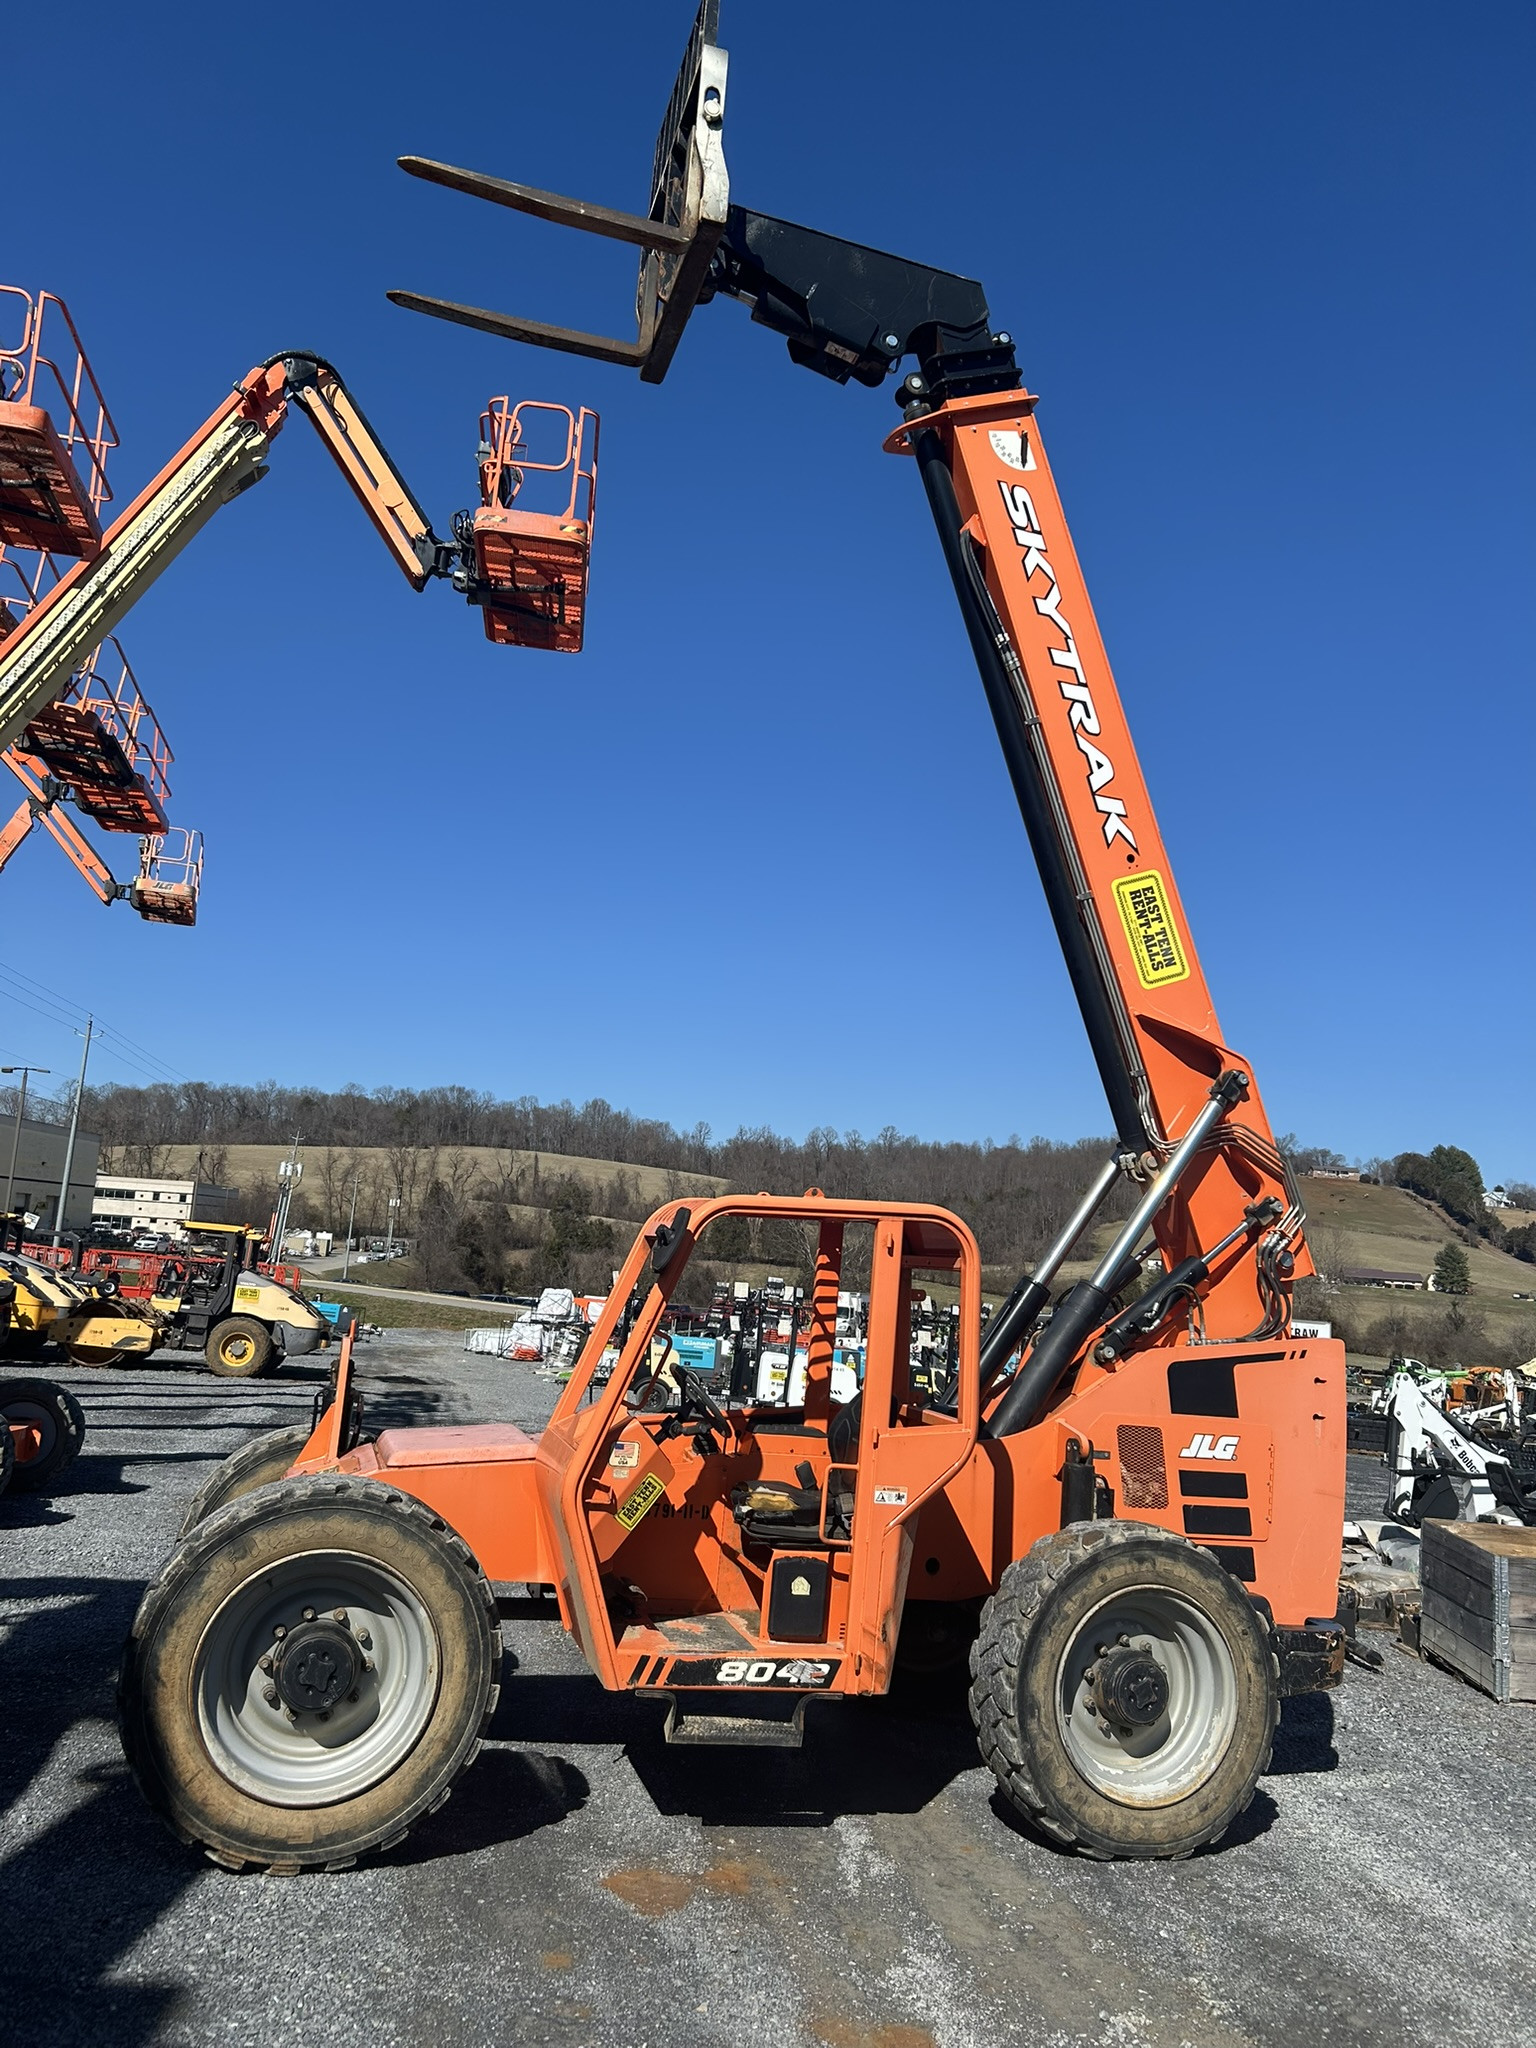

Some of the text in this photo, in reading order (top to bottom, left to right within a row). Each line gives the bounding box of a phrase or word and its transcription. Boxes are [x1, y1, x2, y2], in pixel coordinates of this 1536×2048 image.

[997, 479, 1139, 855] SKYTRAK
[1129, 888, 1164, 972] RENT-ALLS
[1141, 886, 1176, 968] EAST TENN
[1178, 1433, 1241, 1460] JLG
[1457, 1450, 1481, 1474] Bobca
[622, 1480, 653, 1517] EAST TENN
